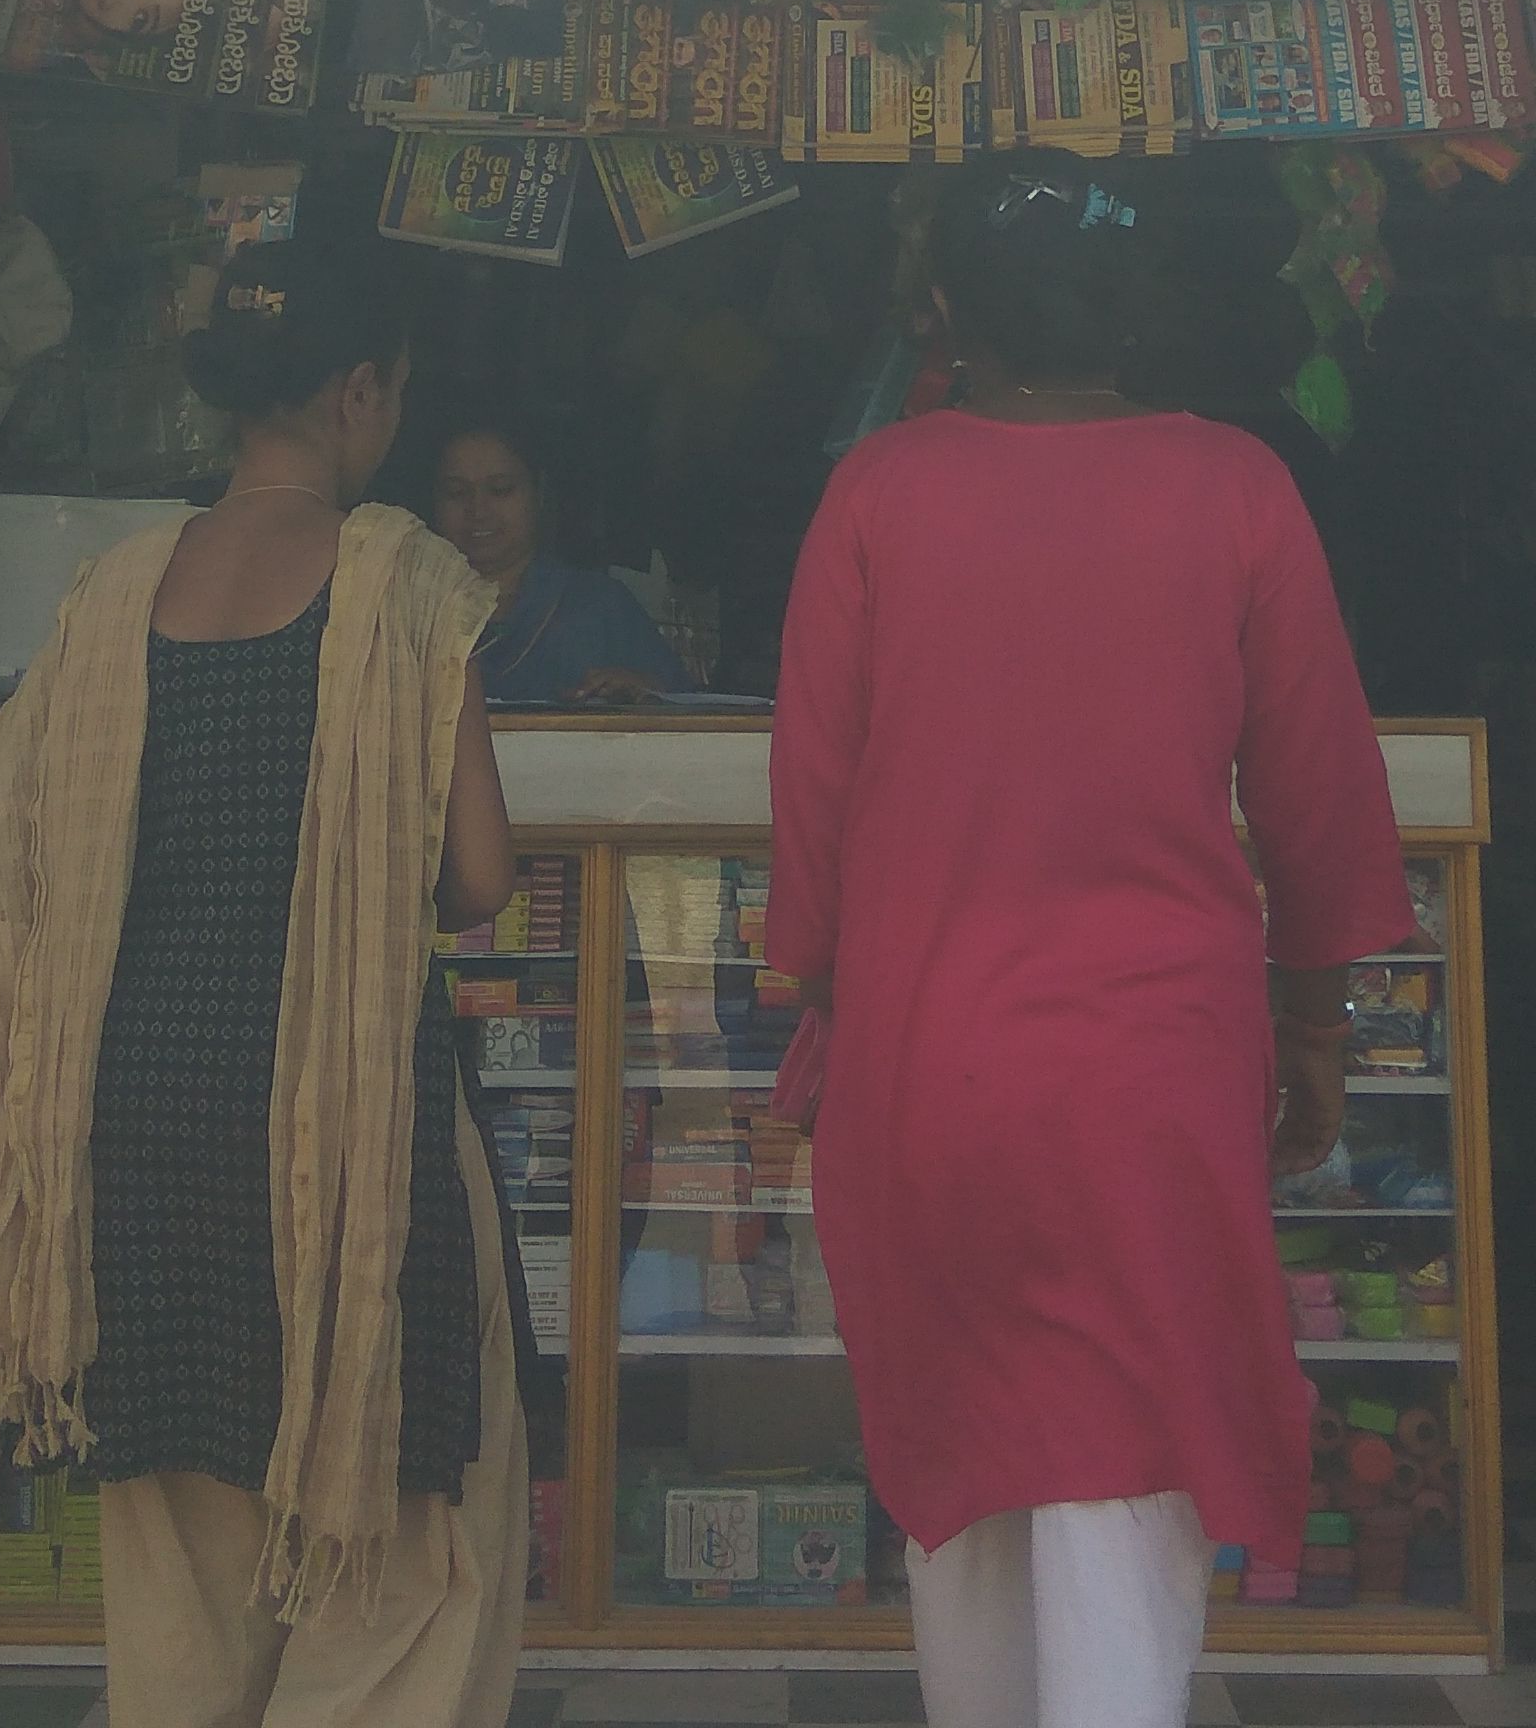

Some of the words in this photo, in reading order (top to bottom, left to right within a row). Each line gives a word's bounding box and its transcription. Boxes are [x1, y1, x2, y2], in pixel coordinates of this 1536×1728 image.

[1119, 53, 1130, 63] &
[1332, 42, 1349, 73] FDA
[1399, 43, 1417, 74] FDA
[1463, 44, 1481, 75] FDA
[912, 85, 932, 138] SDA
[1121, 68, 1142, 120] SDA
[1337, 88, 1355, 123] SDA
[1405, 90, 1424, 125] SDA
[1470, 90, 1488, 125] SDA
